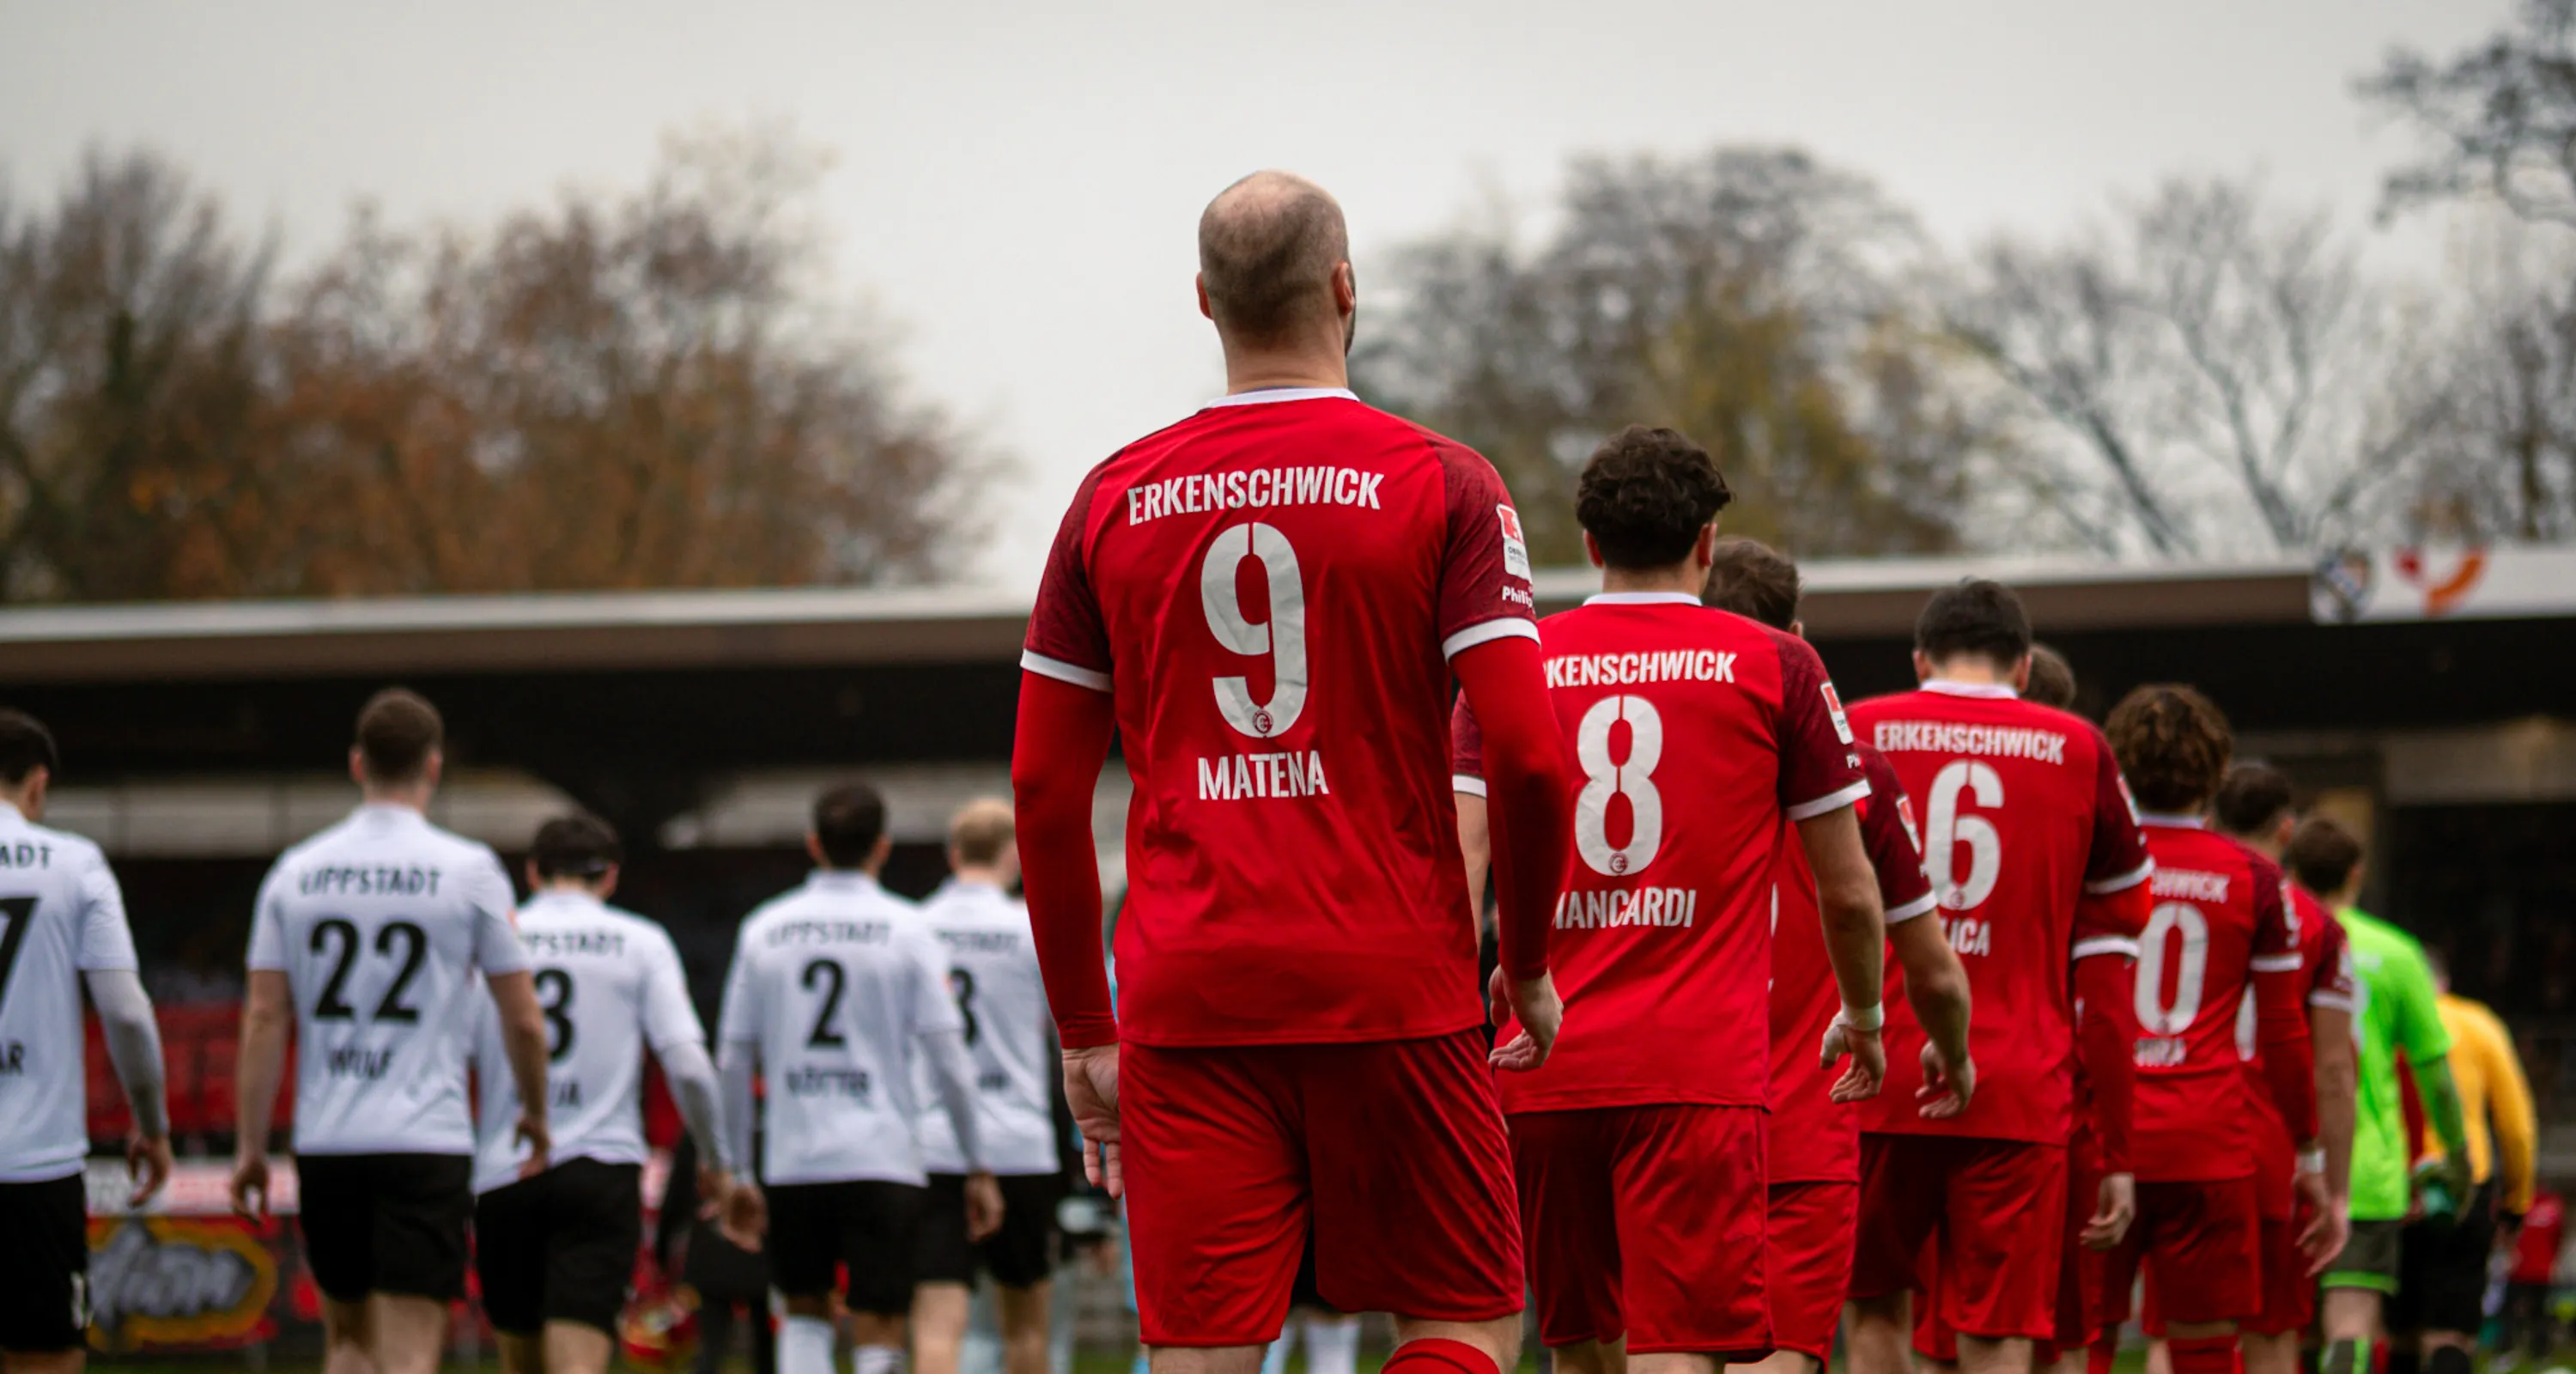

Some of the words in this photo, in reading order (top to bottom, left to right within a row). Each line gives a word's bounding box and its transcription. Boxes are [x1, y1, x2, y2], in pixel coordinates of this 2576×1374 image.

[1127, 465, 1385, 526] ERKENSCHWICK
[1200, 521, 1308, 739] 9
[1543, 646, 1736, 690] KENSCHWICK
[1198, 750, 1330, 800] MATENA
[1874, 720, 2067, 765] ERKENSCHWICK
[1575, 693, 1663, 877] 8
[1925, 758, 2005, 911] 6
[299, 865, 443, 897] LIPPSTADT
[309, 917, 428, 1024] 22
[801, 957, 846, 1051] 2
